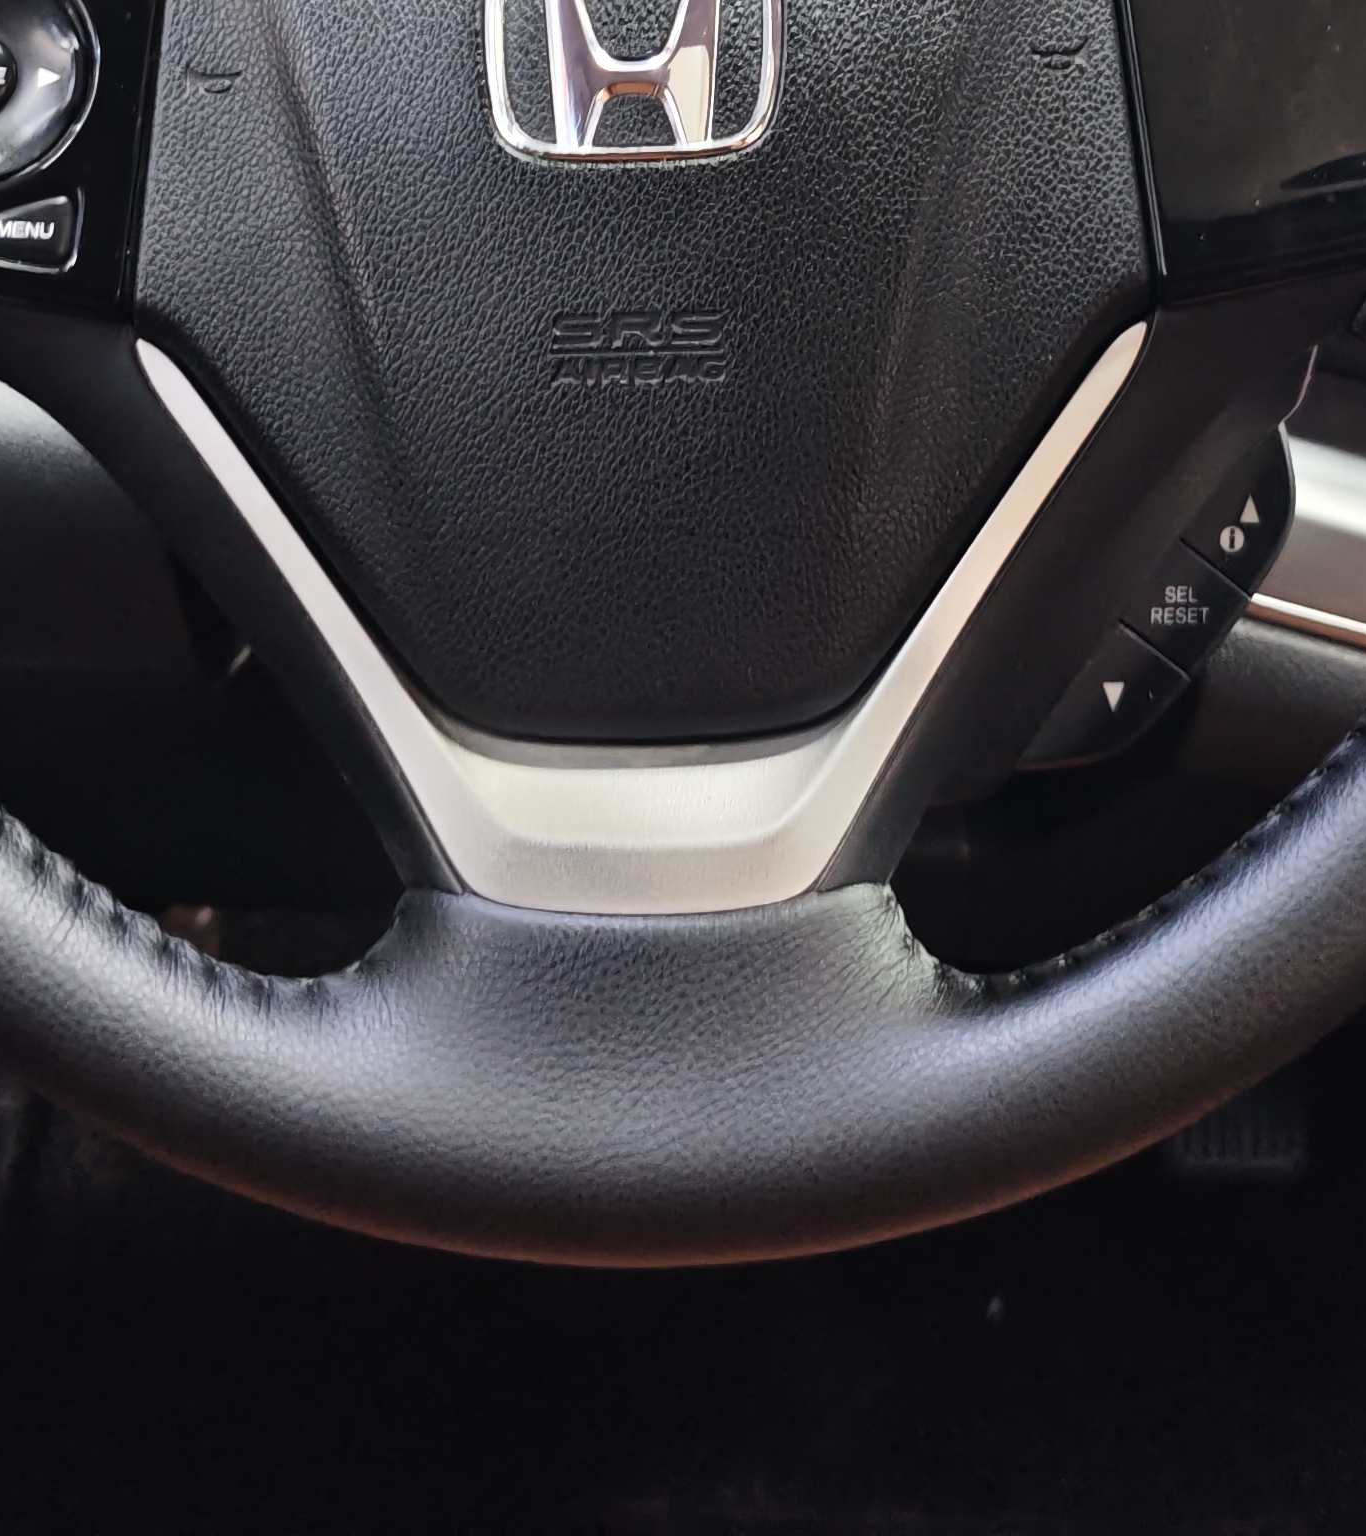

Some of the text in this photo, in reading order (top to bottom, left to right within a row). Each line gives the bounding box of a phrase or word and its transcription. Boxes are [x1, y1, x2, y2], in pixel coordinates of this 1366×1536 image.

[553, 310, 730, 348] SRS
[1164, 585, 1198, 604] SEL
[1150, 607, 1210, 625] RESET
